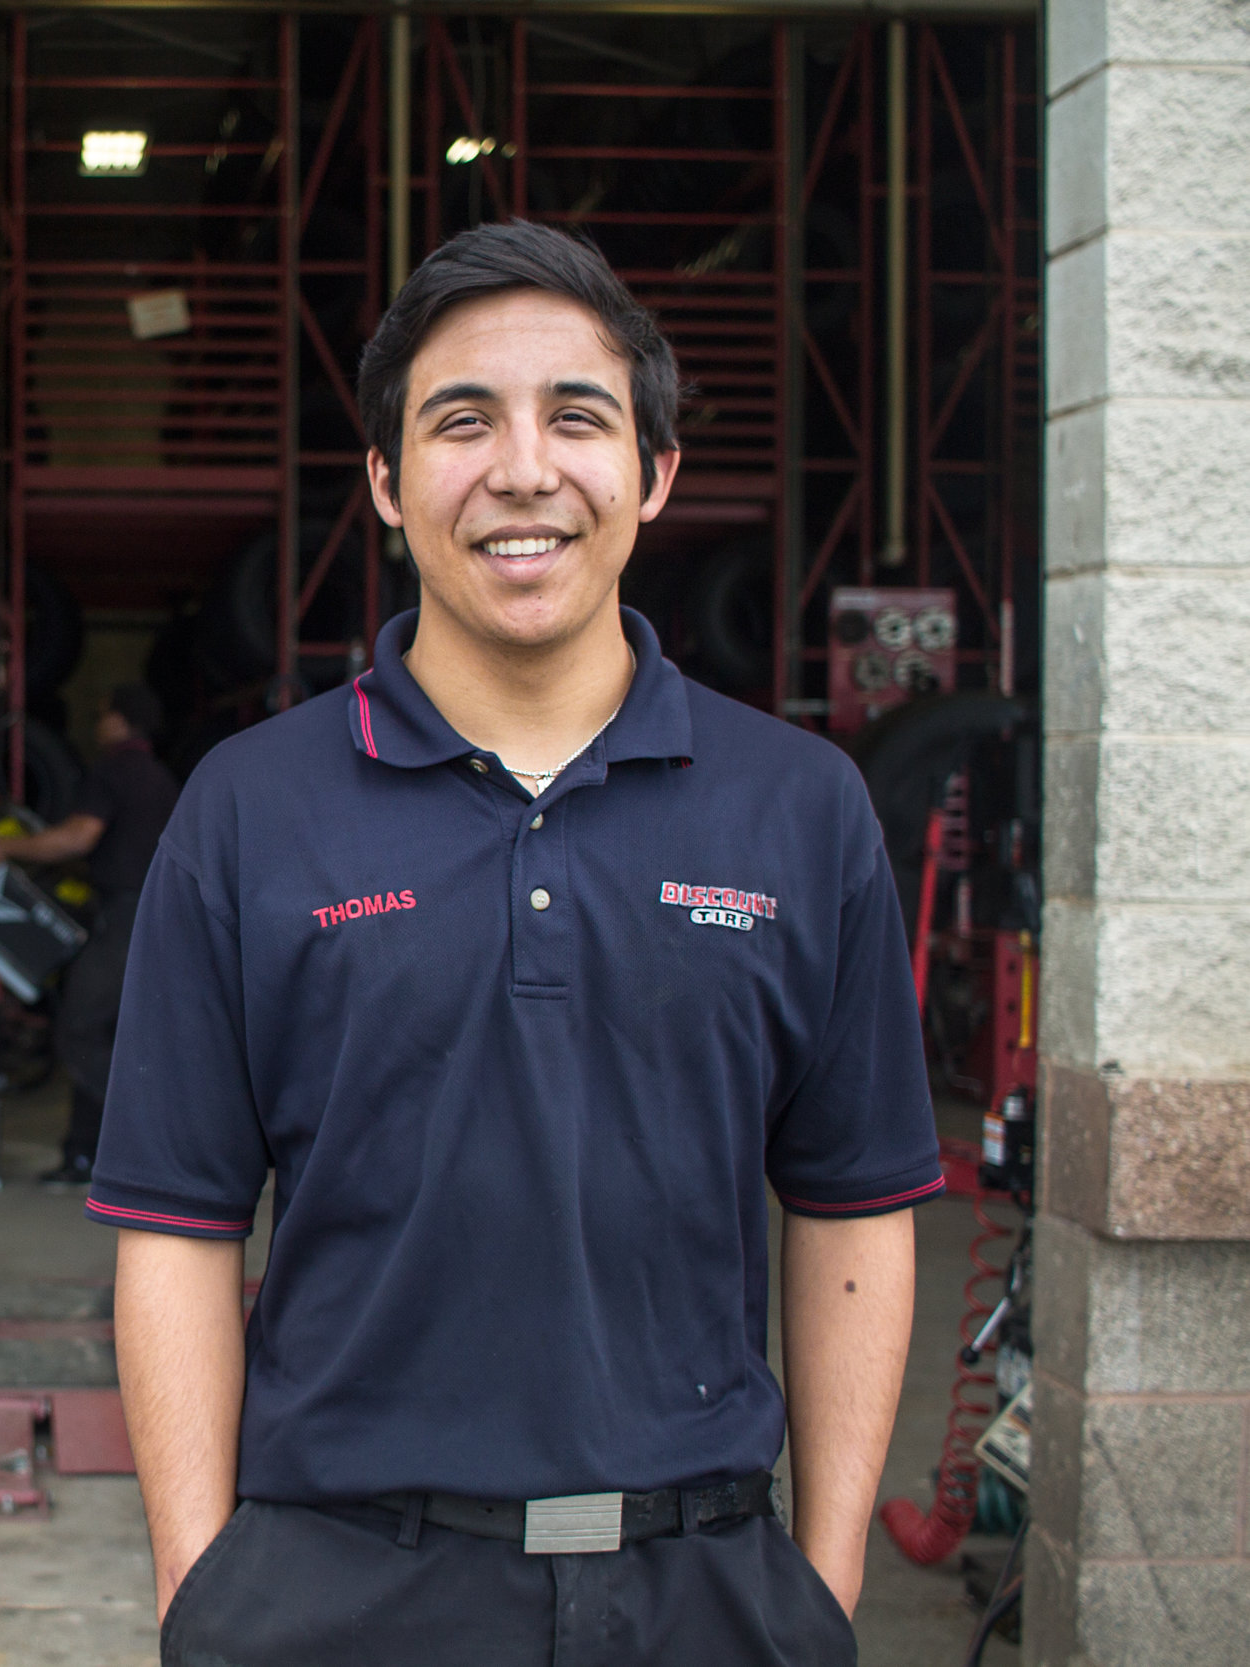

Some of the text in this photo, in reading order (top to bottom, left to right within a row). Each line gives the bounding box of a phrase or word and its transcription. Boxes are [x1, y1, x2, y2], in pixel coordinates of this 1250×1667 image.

[312, 889, 417, 928] THOMAS
[660, 881, 778, 919] DISCOUNT
[697, 910, 751, 930] TIRE
